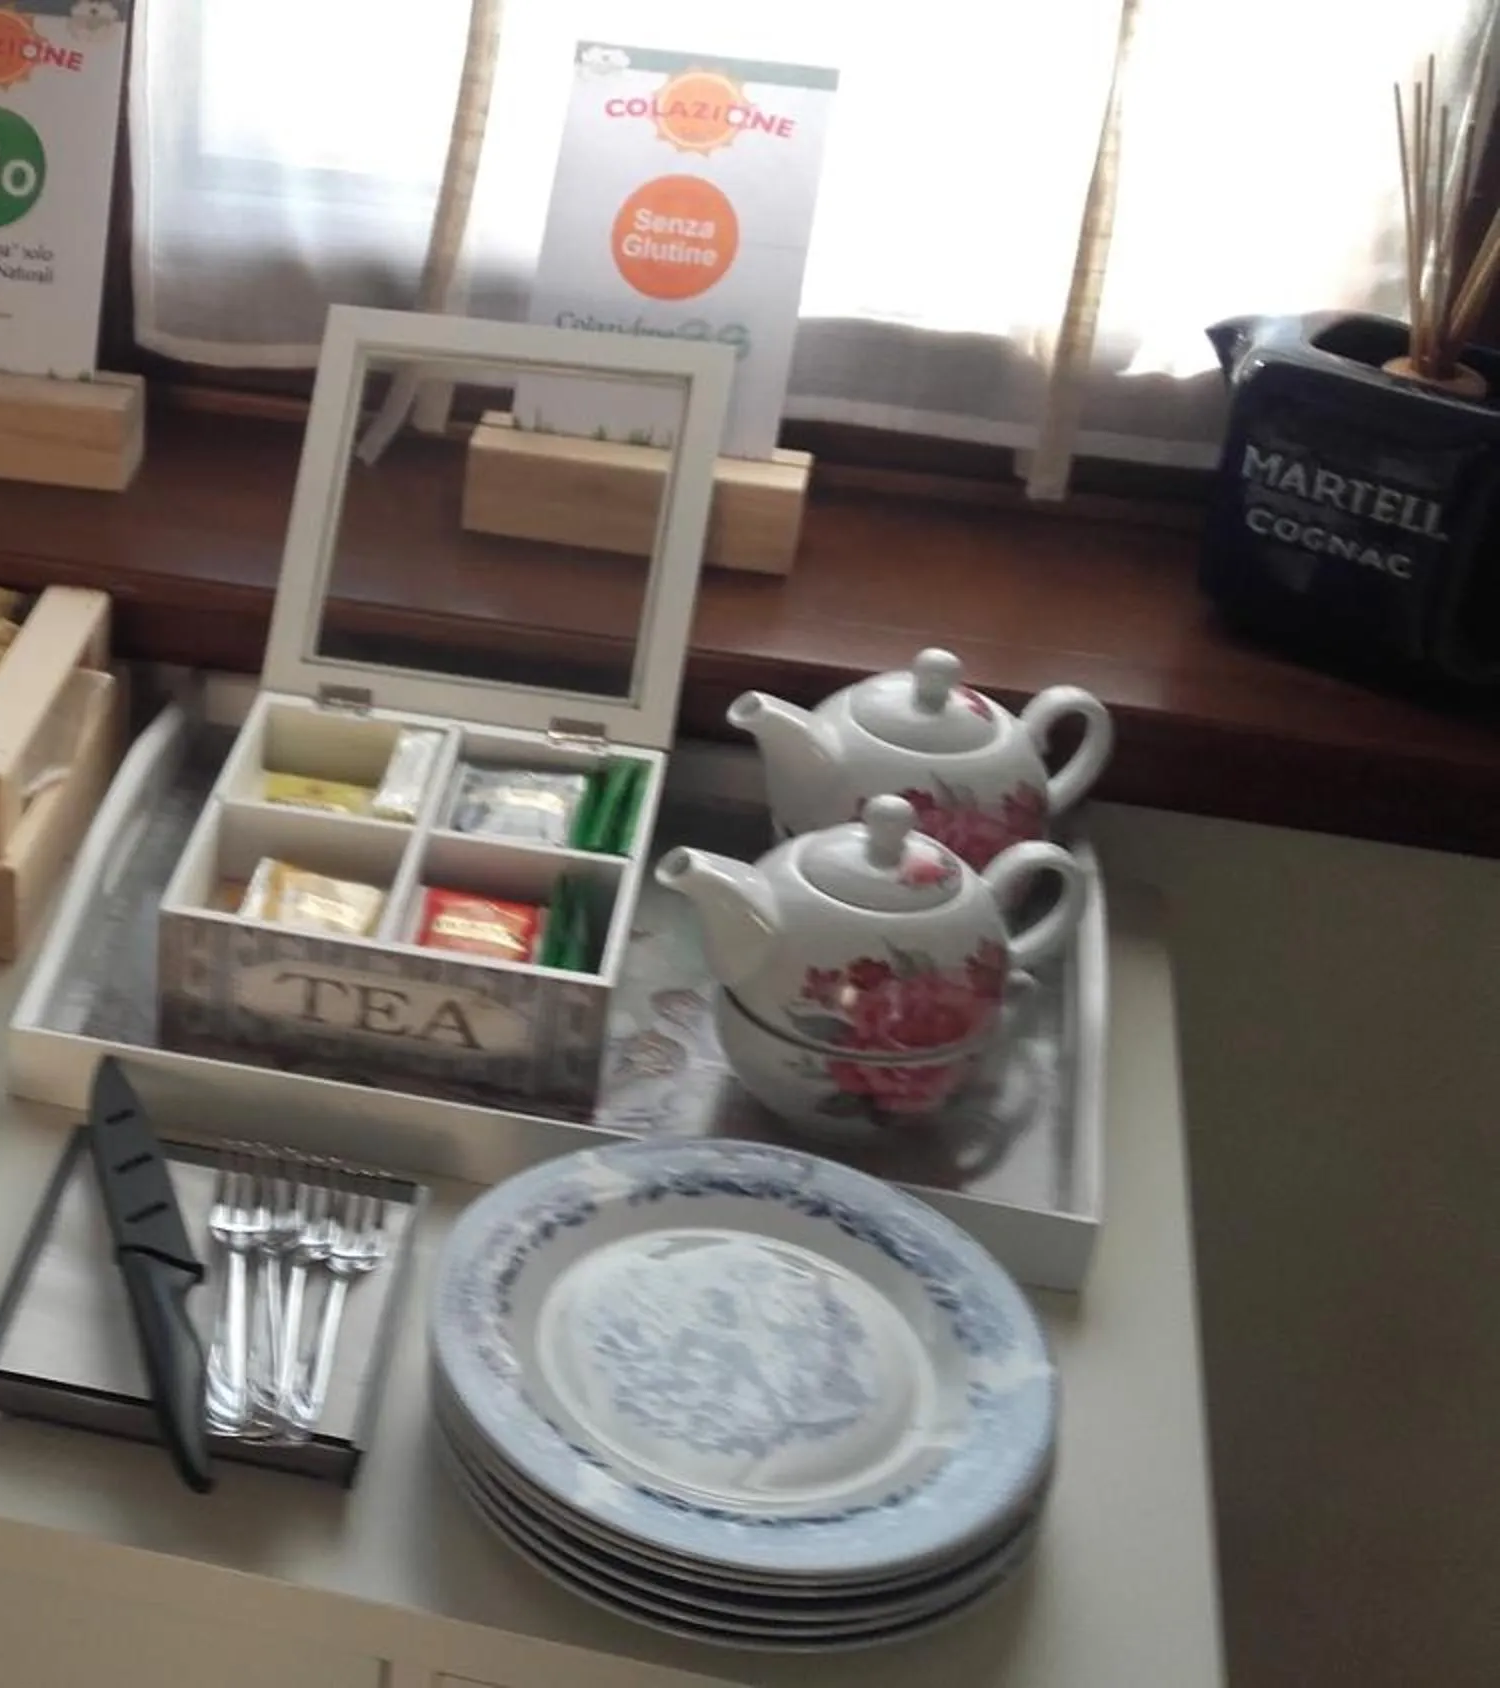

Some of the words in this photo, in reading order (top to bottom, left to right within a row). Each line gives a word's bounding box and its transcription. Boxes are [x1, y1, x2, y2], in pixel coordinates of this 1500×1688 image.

[604, 97, 796, 139] COLAZIONE
[621, 233, 719, 267] Glutine
[633, 207, 717, 240] Senza
[1241, 444, 1449, 542] MARTELL
[1245, 507, 1412, 579] COGNAC
[274, 971, 484, 1051] TEA
